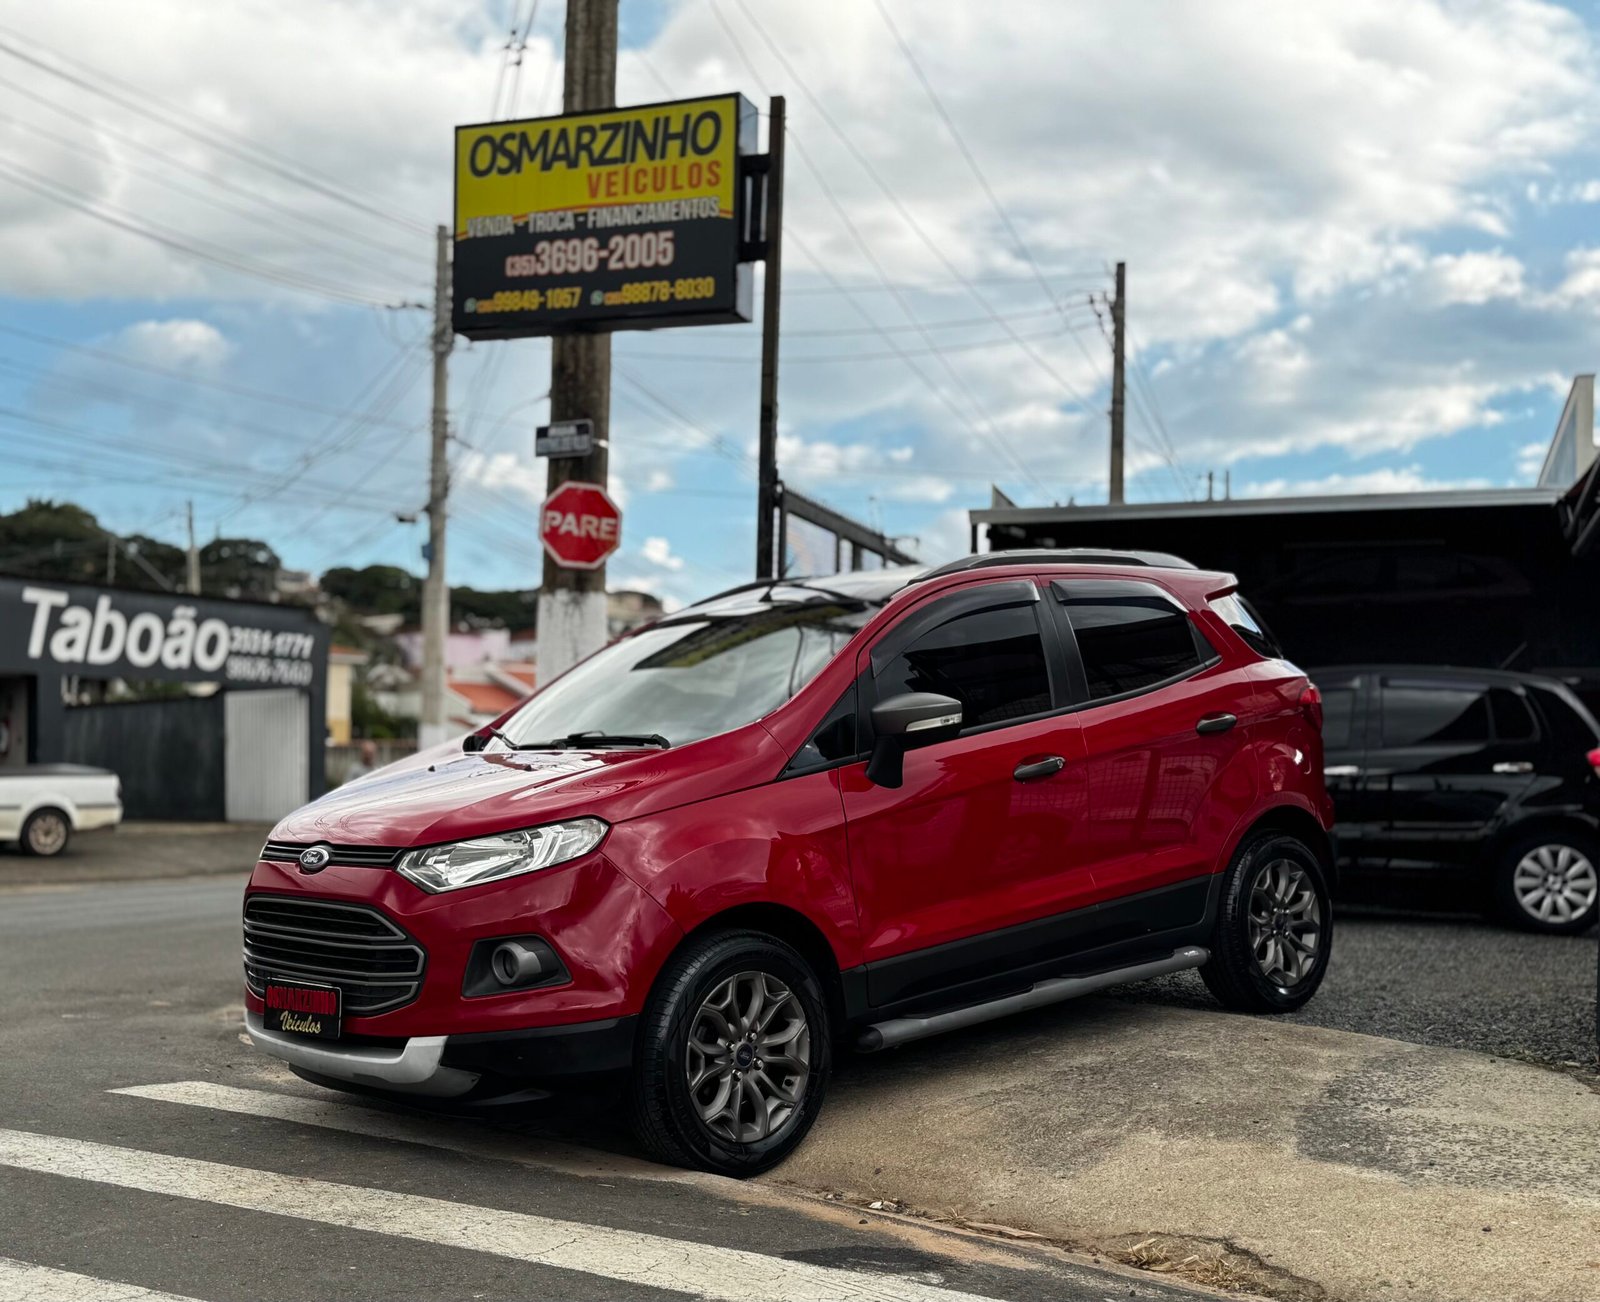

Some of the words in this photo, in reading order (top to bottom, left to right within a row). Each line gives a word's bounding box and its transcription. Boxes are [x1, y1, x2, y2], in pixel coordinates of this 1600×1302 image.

[469, 110, 722, 178] OSMARZINHO
[587, 160, 722, 200] VEÍCULOS
[466, 214, 515, 238] VENDA
[527, 210, 576, 234] TROCA
[586, 197, 721, 229] FINANCIAMENTOS
[543, 510, 617, 541] PARE
[21, 586, 230, 672] Taboão
[303, 850, 321, 864] Ford
